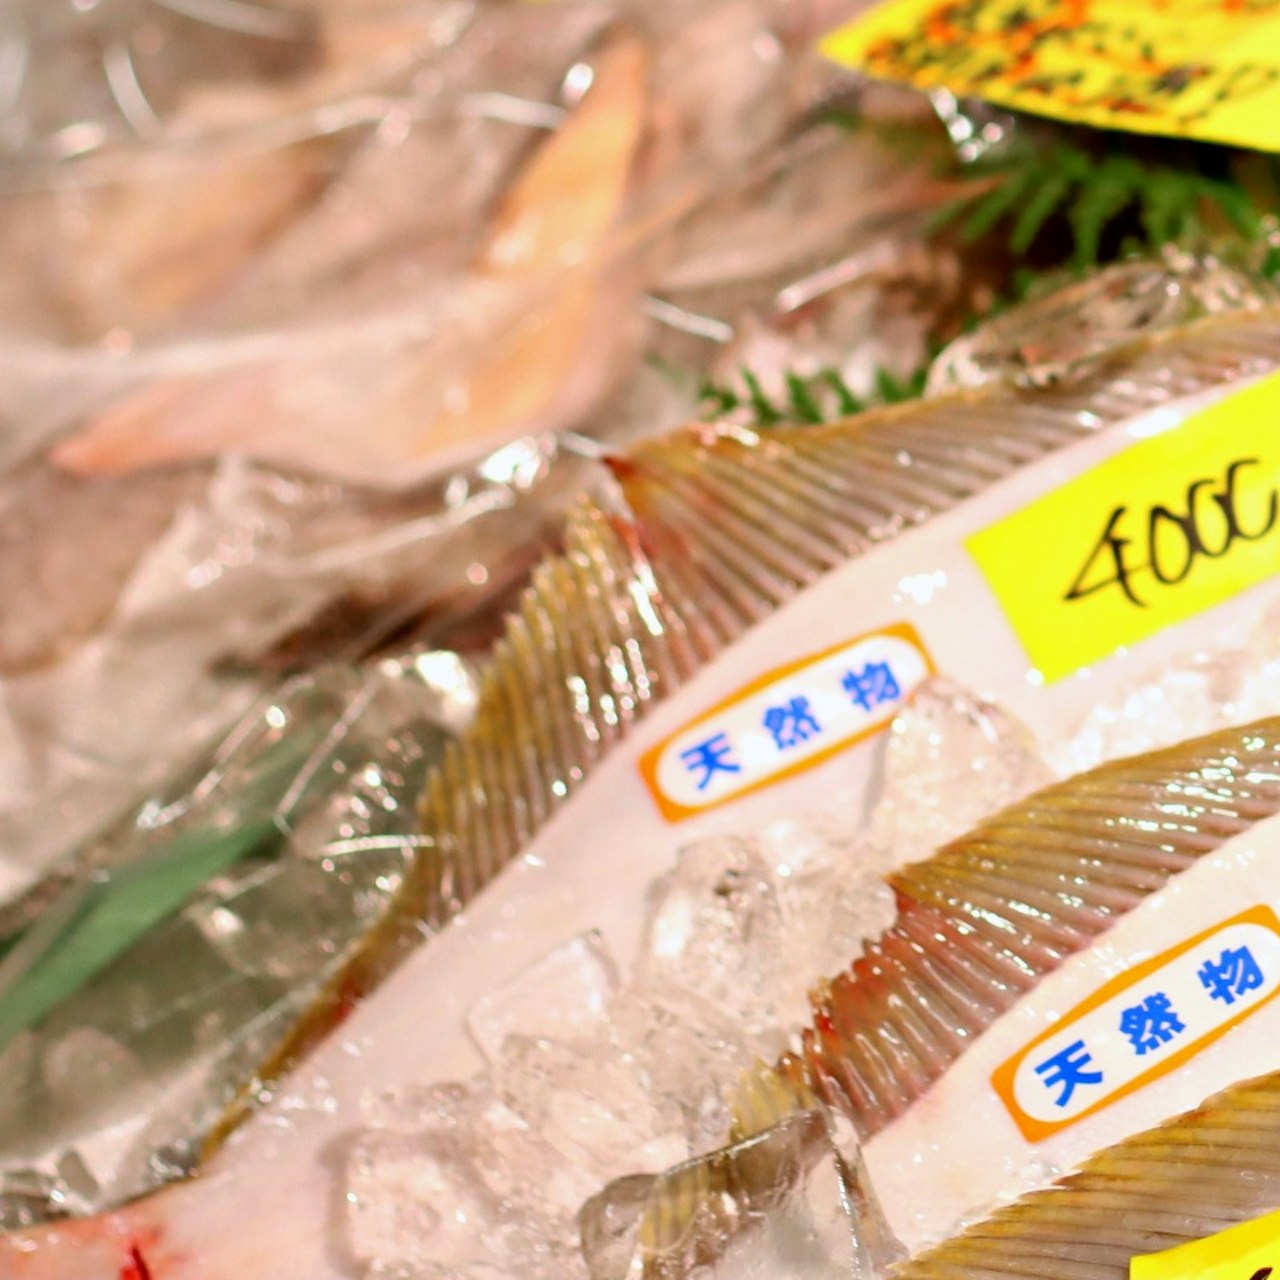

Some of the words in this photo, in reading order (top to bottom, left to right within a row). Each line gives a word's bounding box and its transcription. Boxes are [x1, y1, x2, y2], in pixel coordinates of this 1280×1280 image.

[1064, 457, 1278, 609] 4000
[680, 660, 906, 788] 天然物
[1034, 945, 1266, 1106] 天然物
